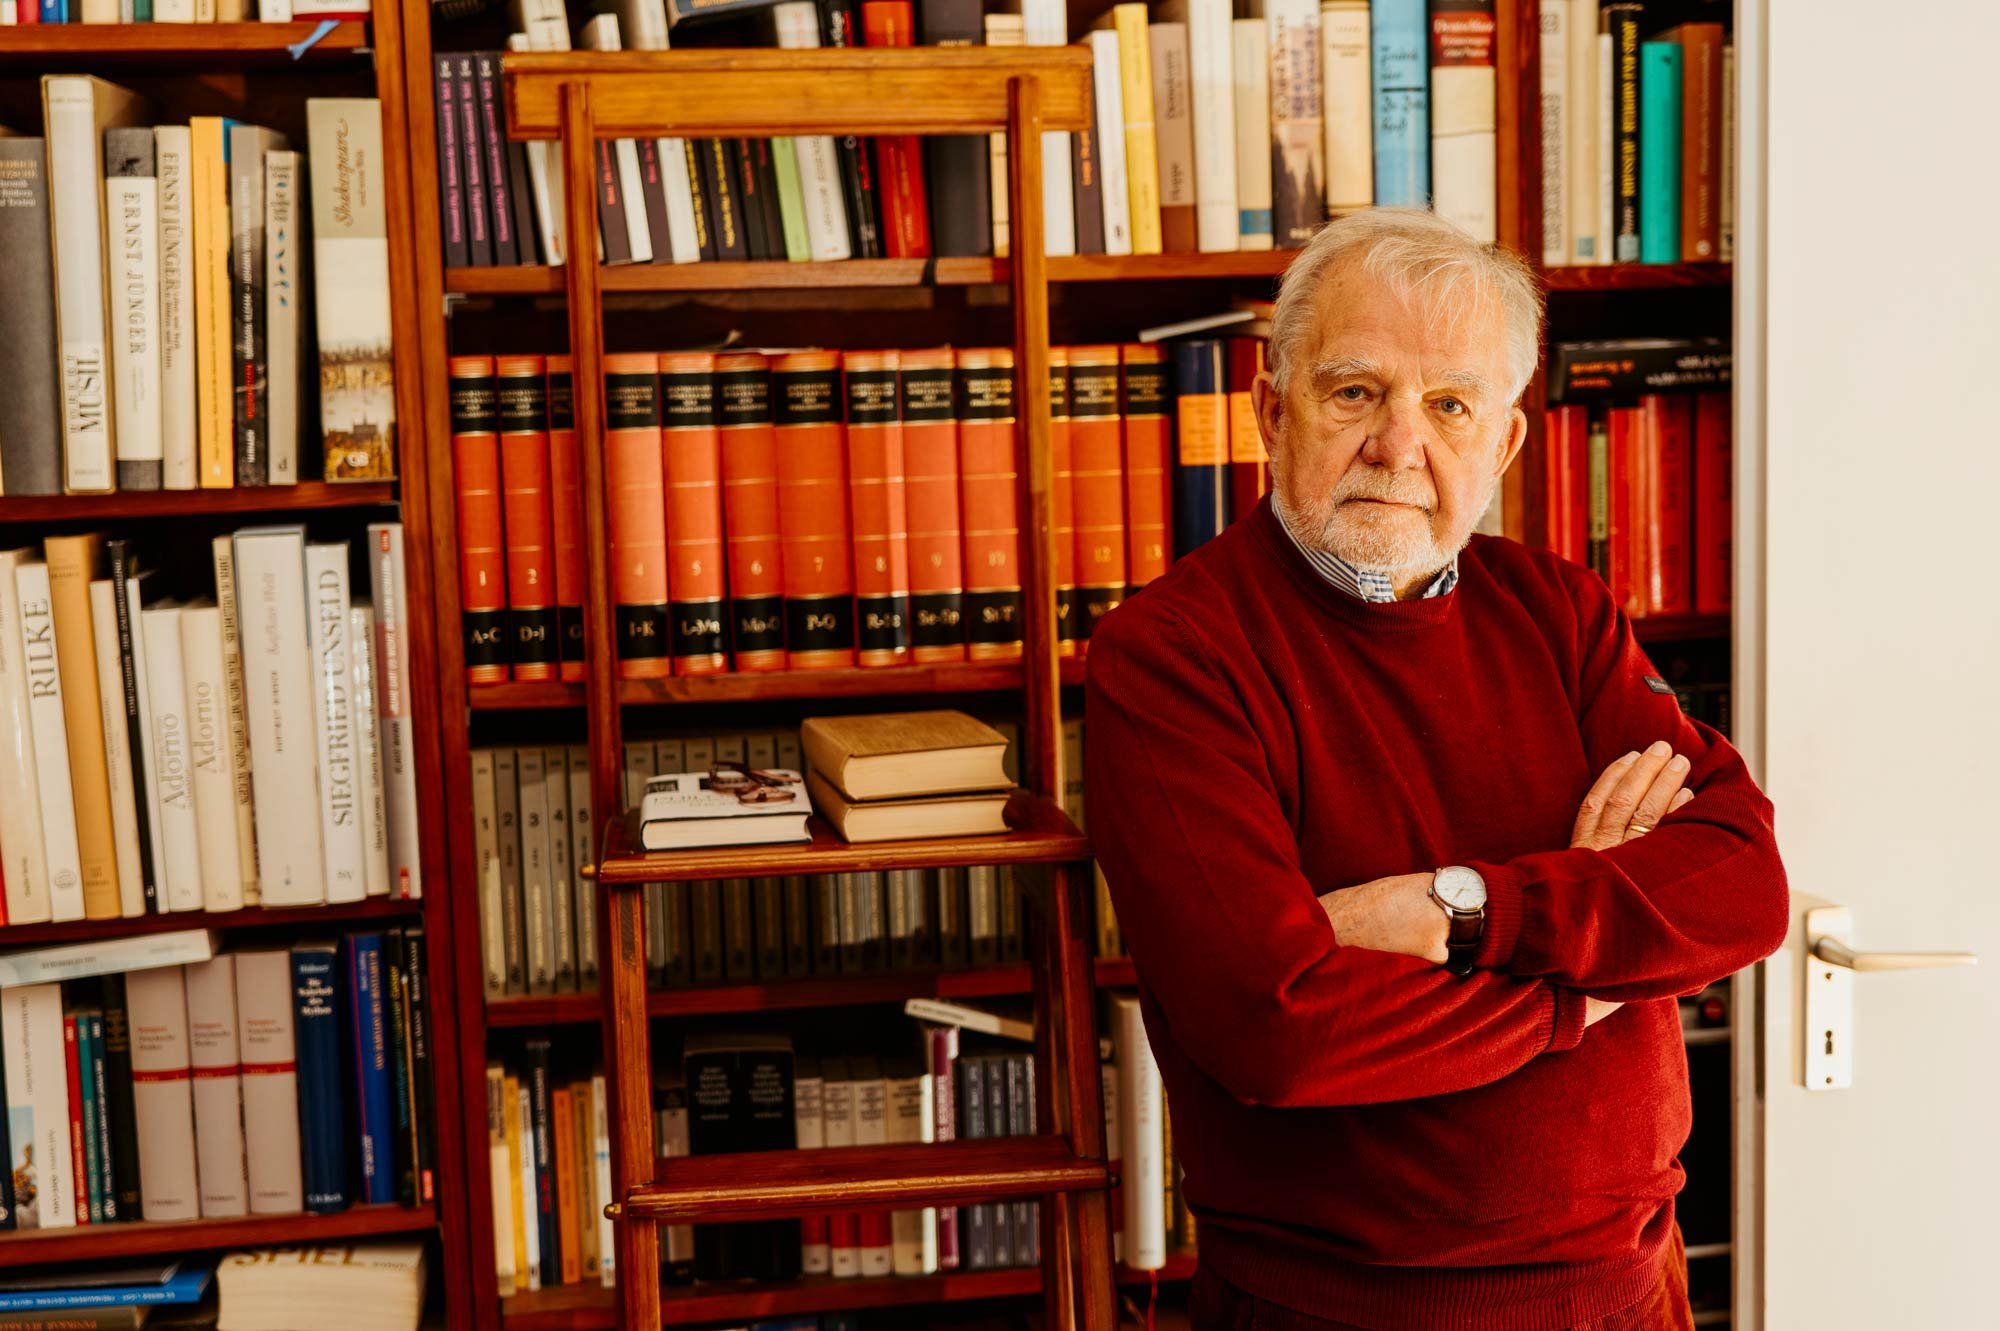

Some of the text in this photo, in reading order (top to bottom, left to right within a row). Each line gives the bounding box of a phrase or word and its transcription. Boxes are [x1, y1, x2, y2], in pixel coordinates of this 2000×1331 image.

[124, 192, 143, 260] ERNST
[162, 151, 182, 292] ERNST JÜNGER
[127, 270, 147, 354] JÜNGER
[77, 350, 103, 432] MUSIL
[24, 597, 57, 700] RILKE
[194, 681, 217, 775] Adorno
[319, 567, 353, 827] SIEGFRIED UNSELD
[160, 712, 186, 811] Adorno
